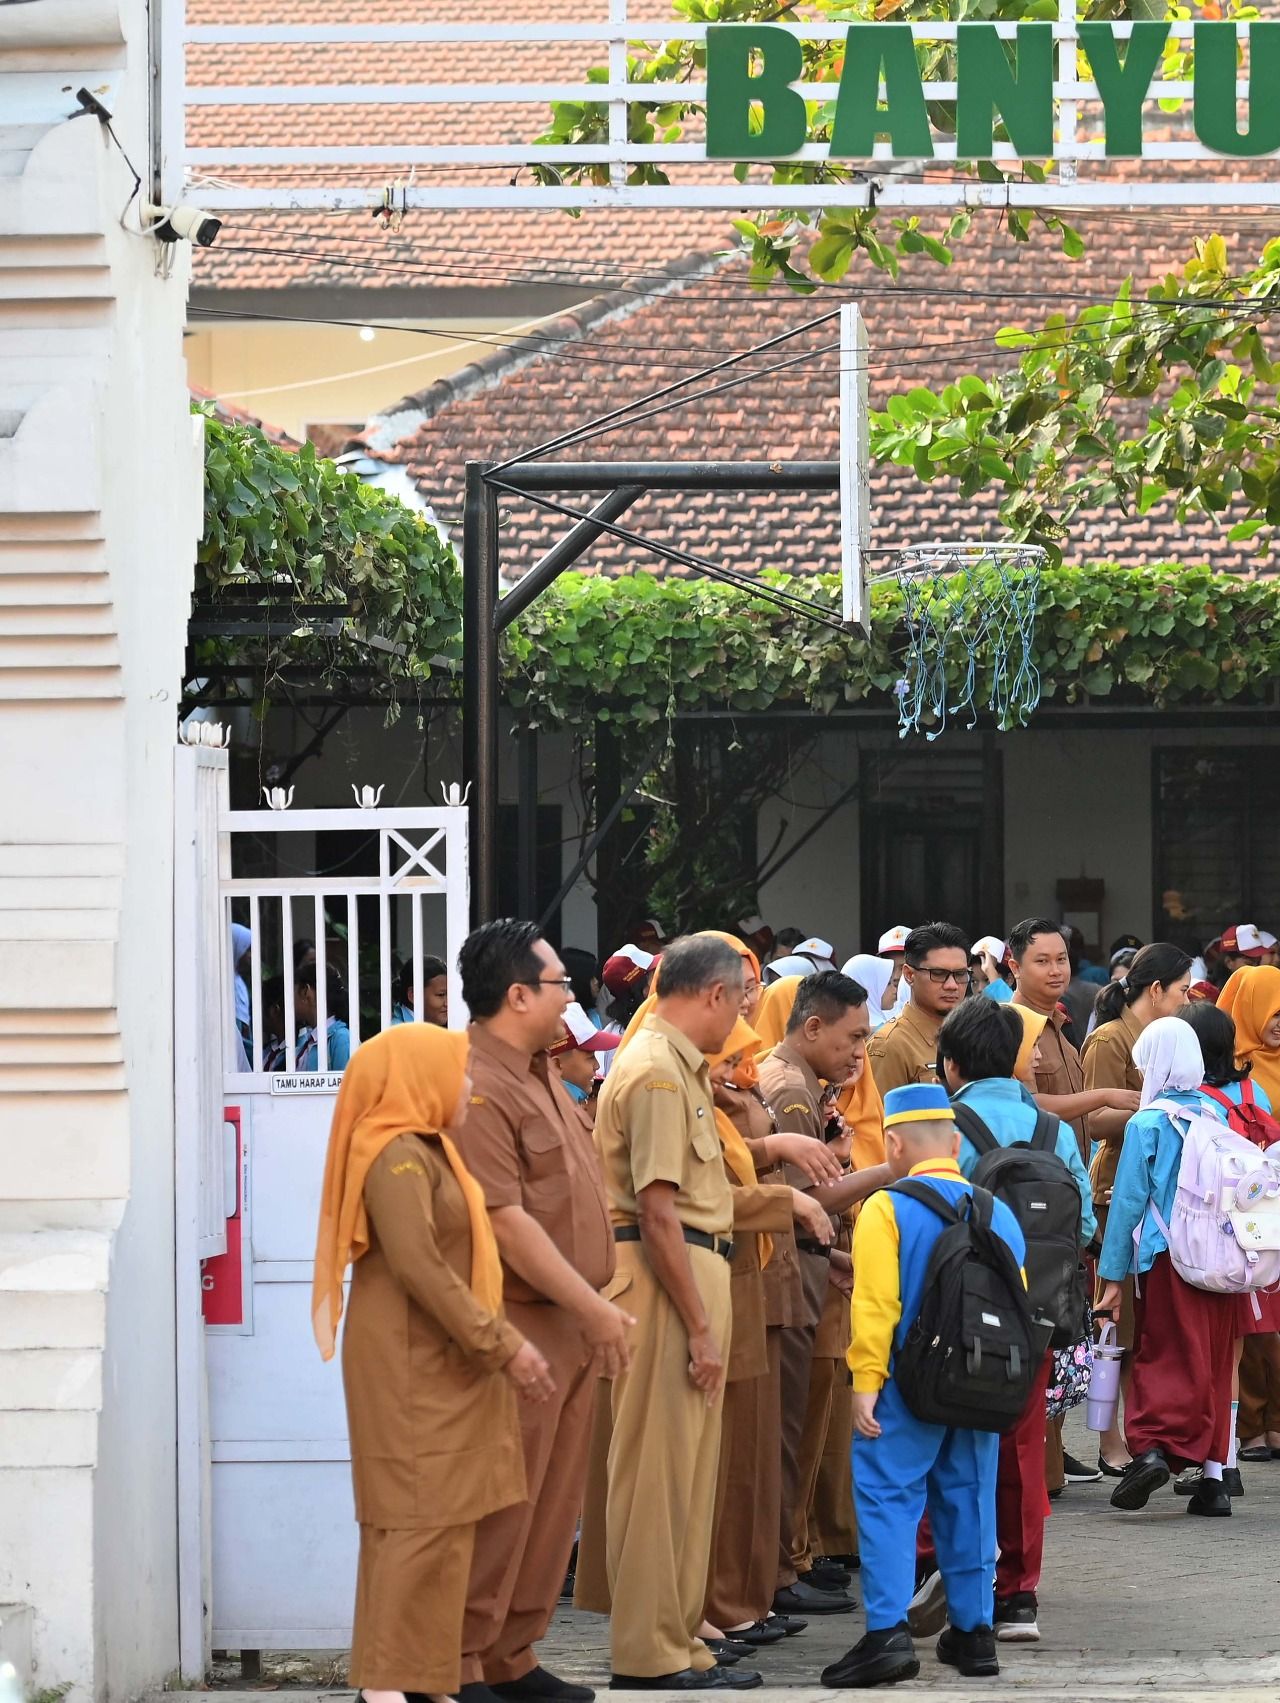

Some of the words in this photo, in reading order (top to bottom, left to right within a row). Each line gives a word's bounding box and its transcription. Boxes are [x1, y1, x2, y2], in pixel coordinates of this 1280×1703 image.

[276, 1079, 297, 1088] TAMU
[300, 1078, 325, 1088] HARAP
[327, 1077, 342, 1087] LAP
